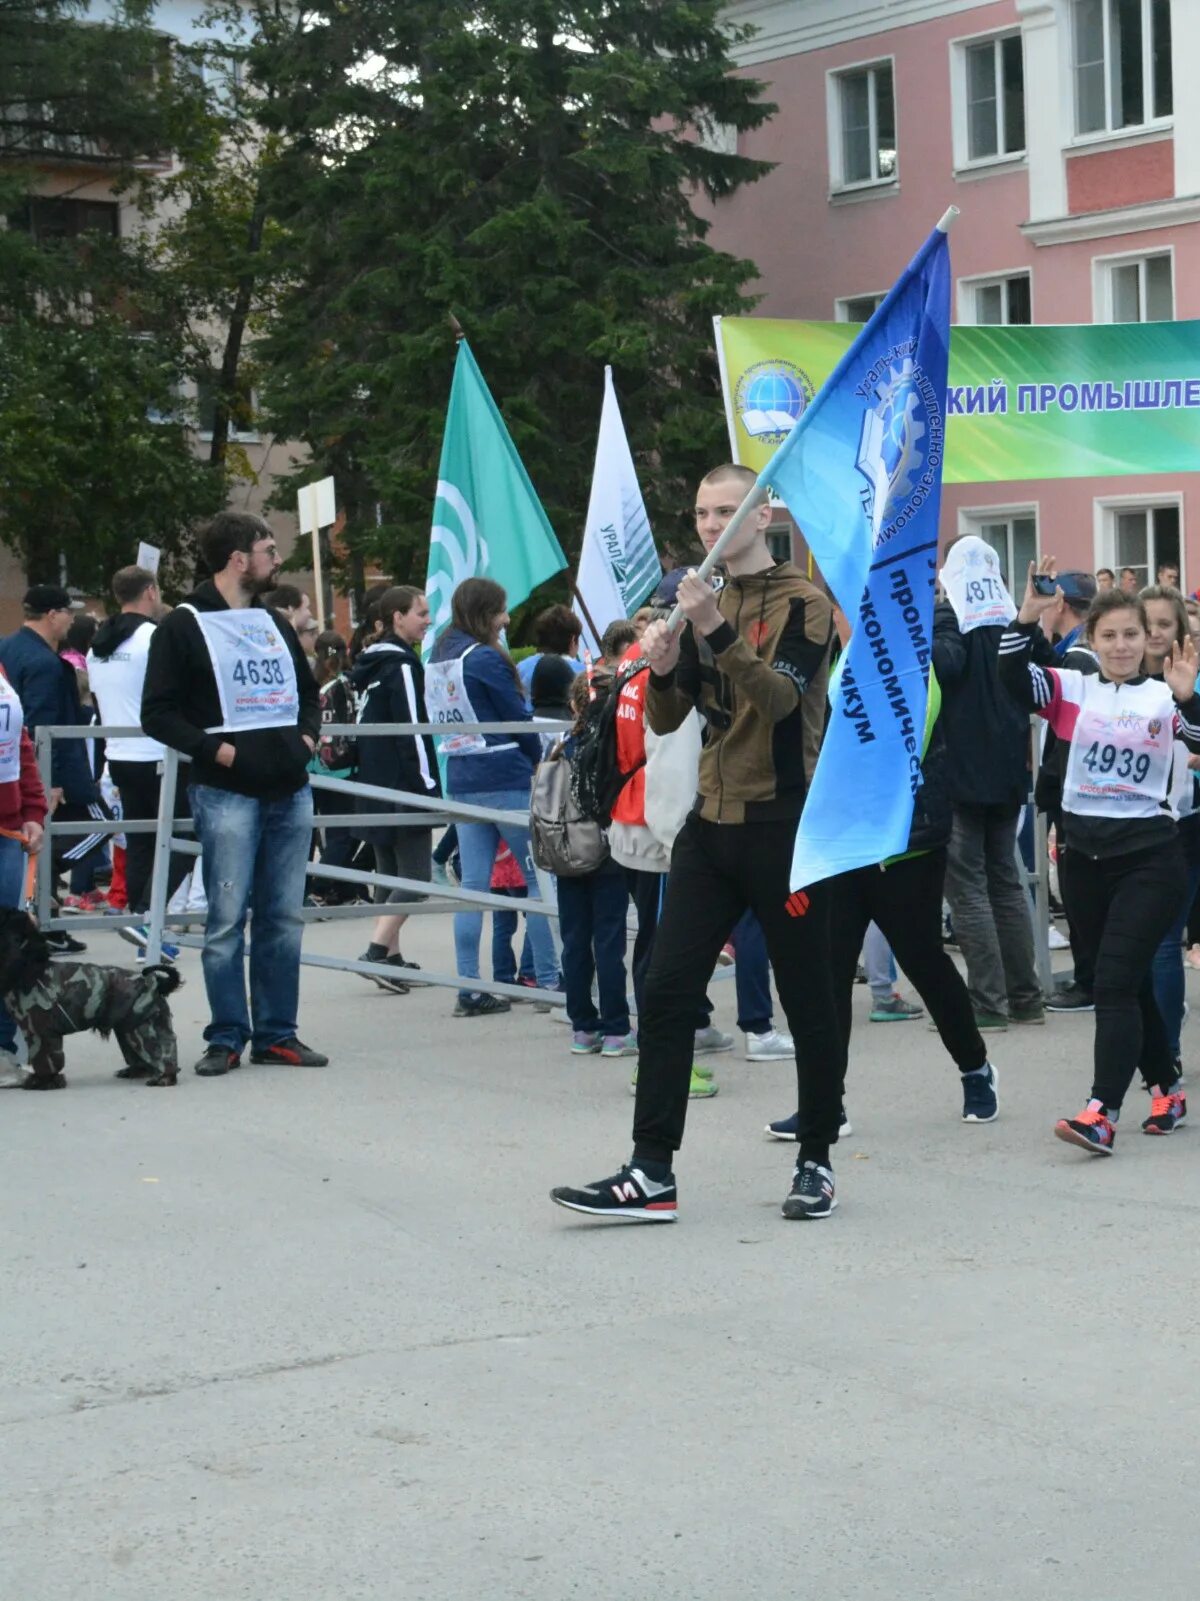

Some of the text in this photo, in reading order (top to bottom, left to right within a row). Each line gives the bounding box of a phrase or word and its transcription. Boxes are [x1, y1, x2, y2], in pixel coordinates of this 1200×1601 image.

[600, 523, 622, 558] УРАЛ
[232, 658, 285, 686] 4638
[0, 703, 11, 732] 7
[1082, 740, 1152, 785] 4939
